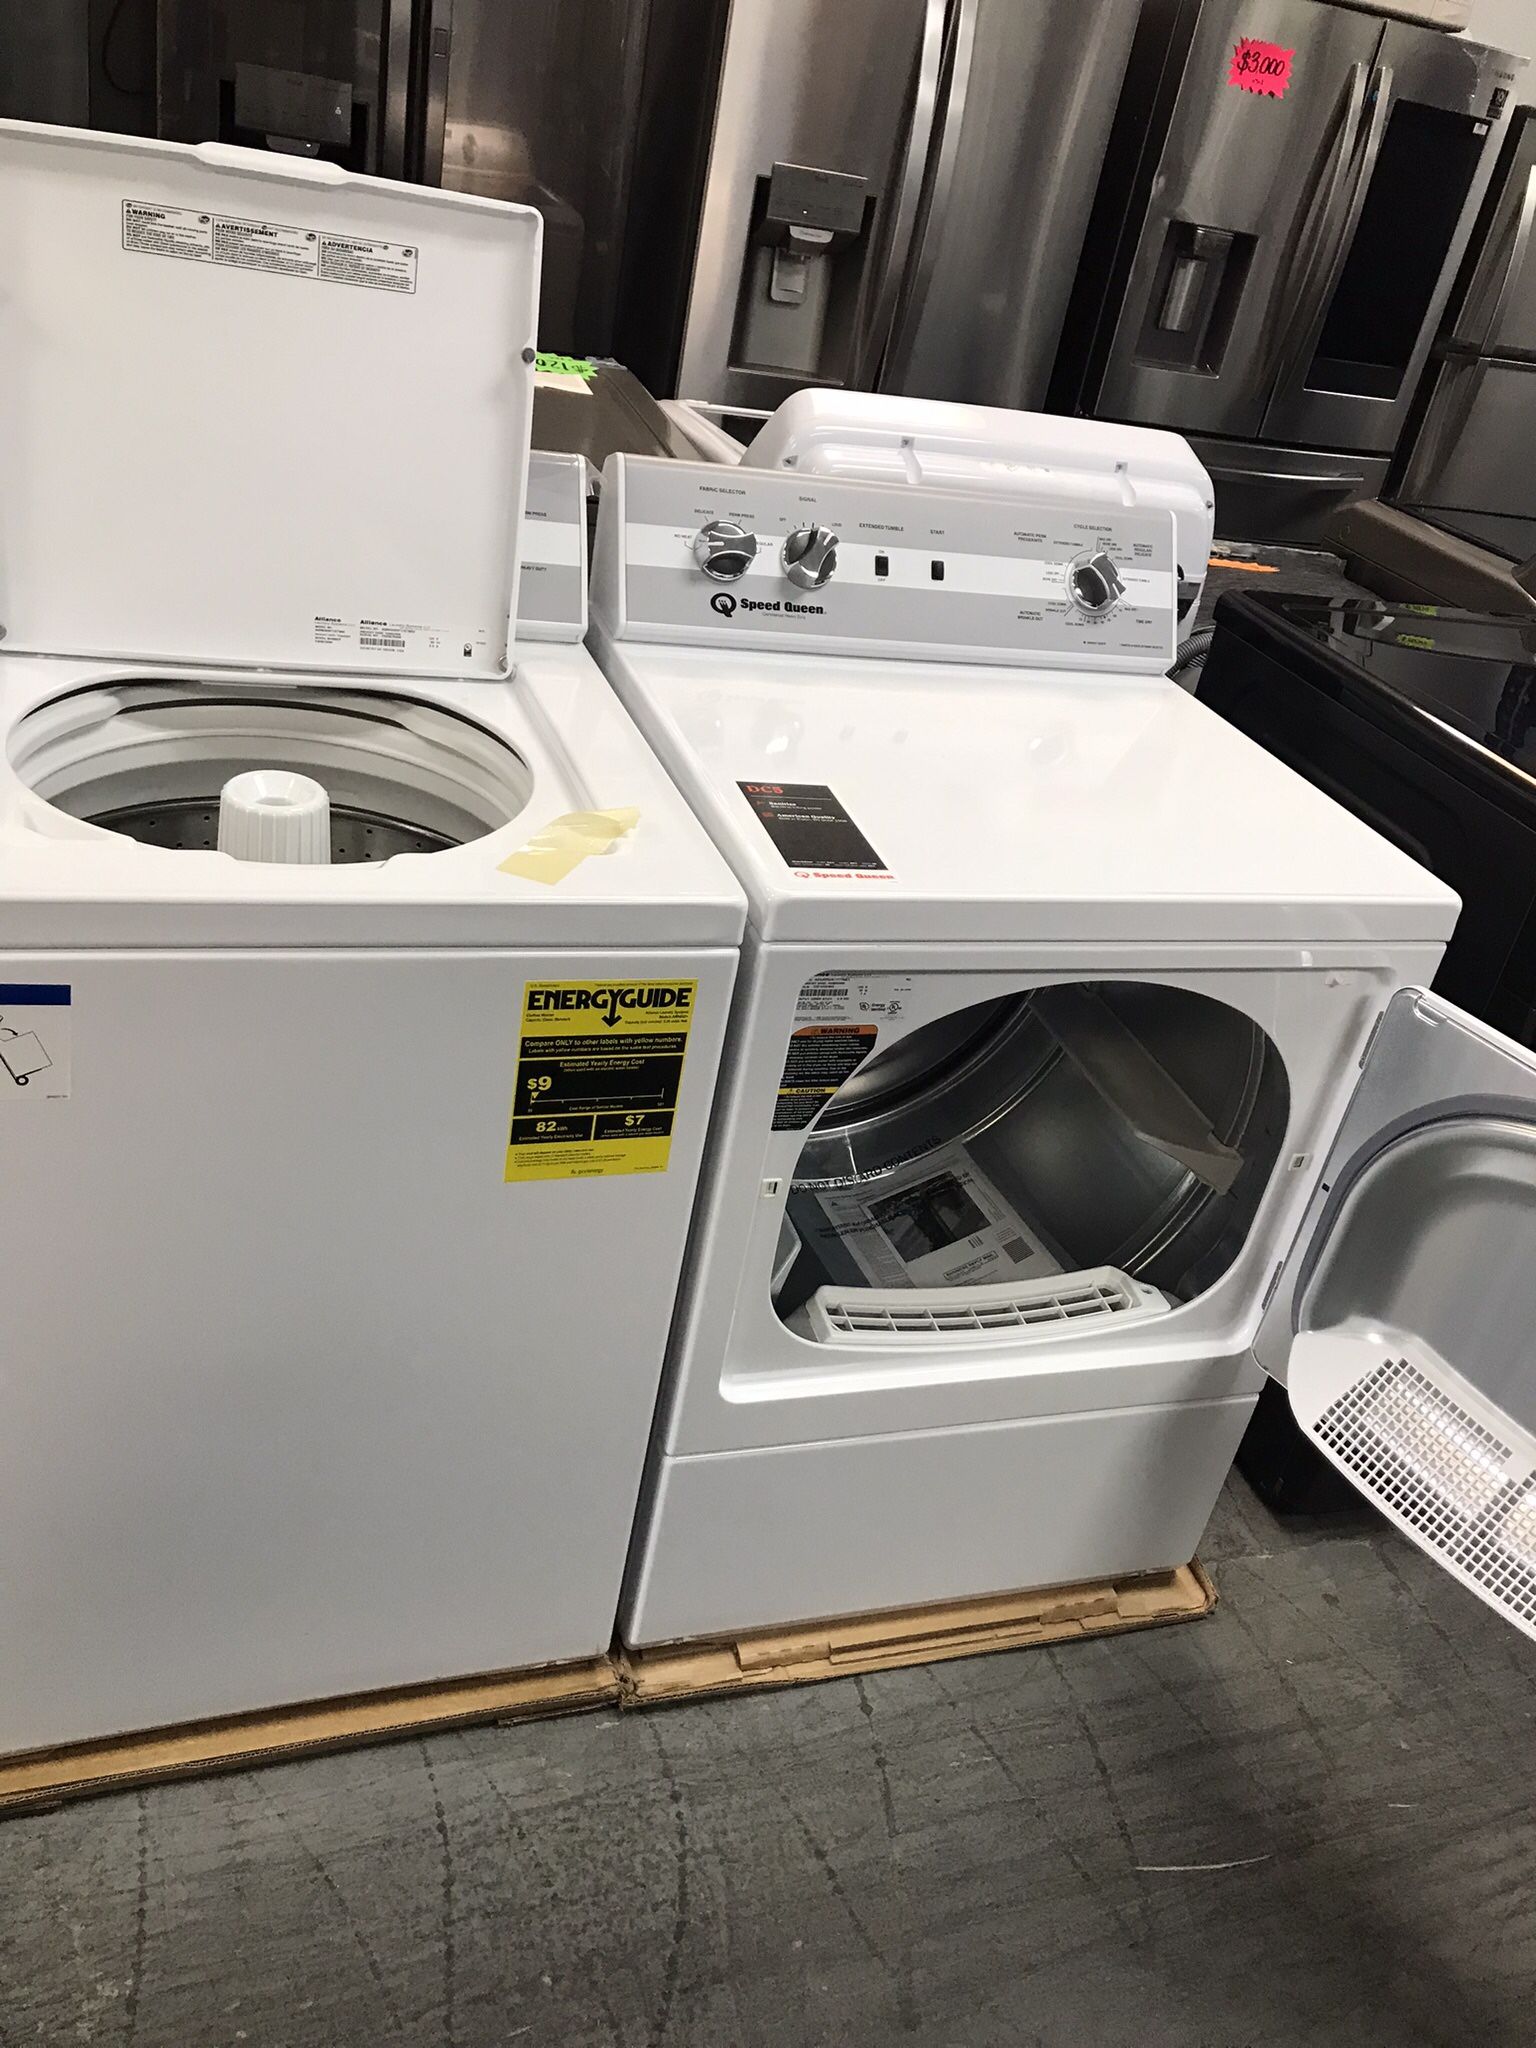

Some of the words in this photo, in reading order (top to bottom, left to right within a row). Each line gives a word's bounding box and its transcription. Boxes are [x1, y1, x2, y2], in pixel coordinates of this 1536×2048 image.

[132, 208, 166, 220] WARNING
[221, 223, 278, 237] AVERTISSEMENT
[327, 241, 373, 253] ADVERTENCIA
[859, 523, 885, 531] EXTENDED
[885, 524, 904, 532] TUMBLE
[740, 598, 780, 611] Speed
[784, 601, 824, 614] Queen
[527, 987, 692, 1012] ENERGYGUIDE
[524, 1040, 554, 1048] Compare
[609, 1059, 630, 1067] Energy
[527, 1075, 552, 1091] $9
[536, 1120, 557, 1132] 82
[624, 1114, 646, 1126] $7
[790, 1183, 806, 1194] DO
[808, 1180, 830, 1191] NOT
[834, 1165, 884, 1187] DISCARD
[884, 1135, 943, 1170] CONTENTS
